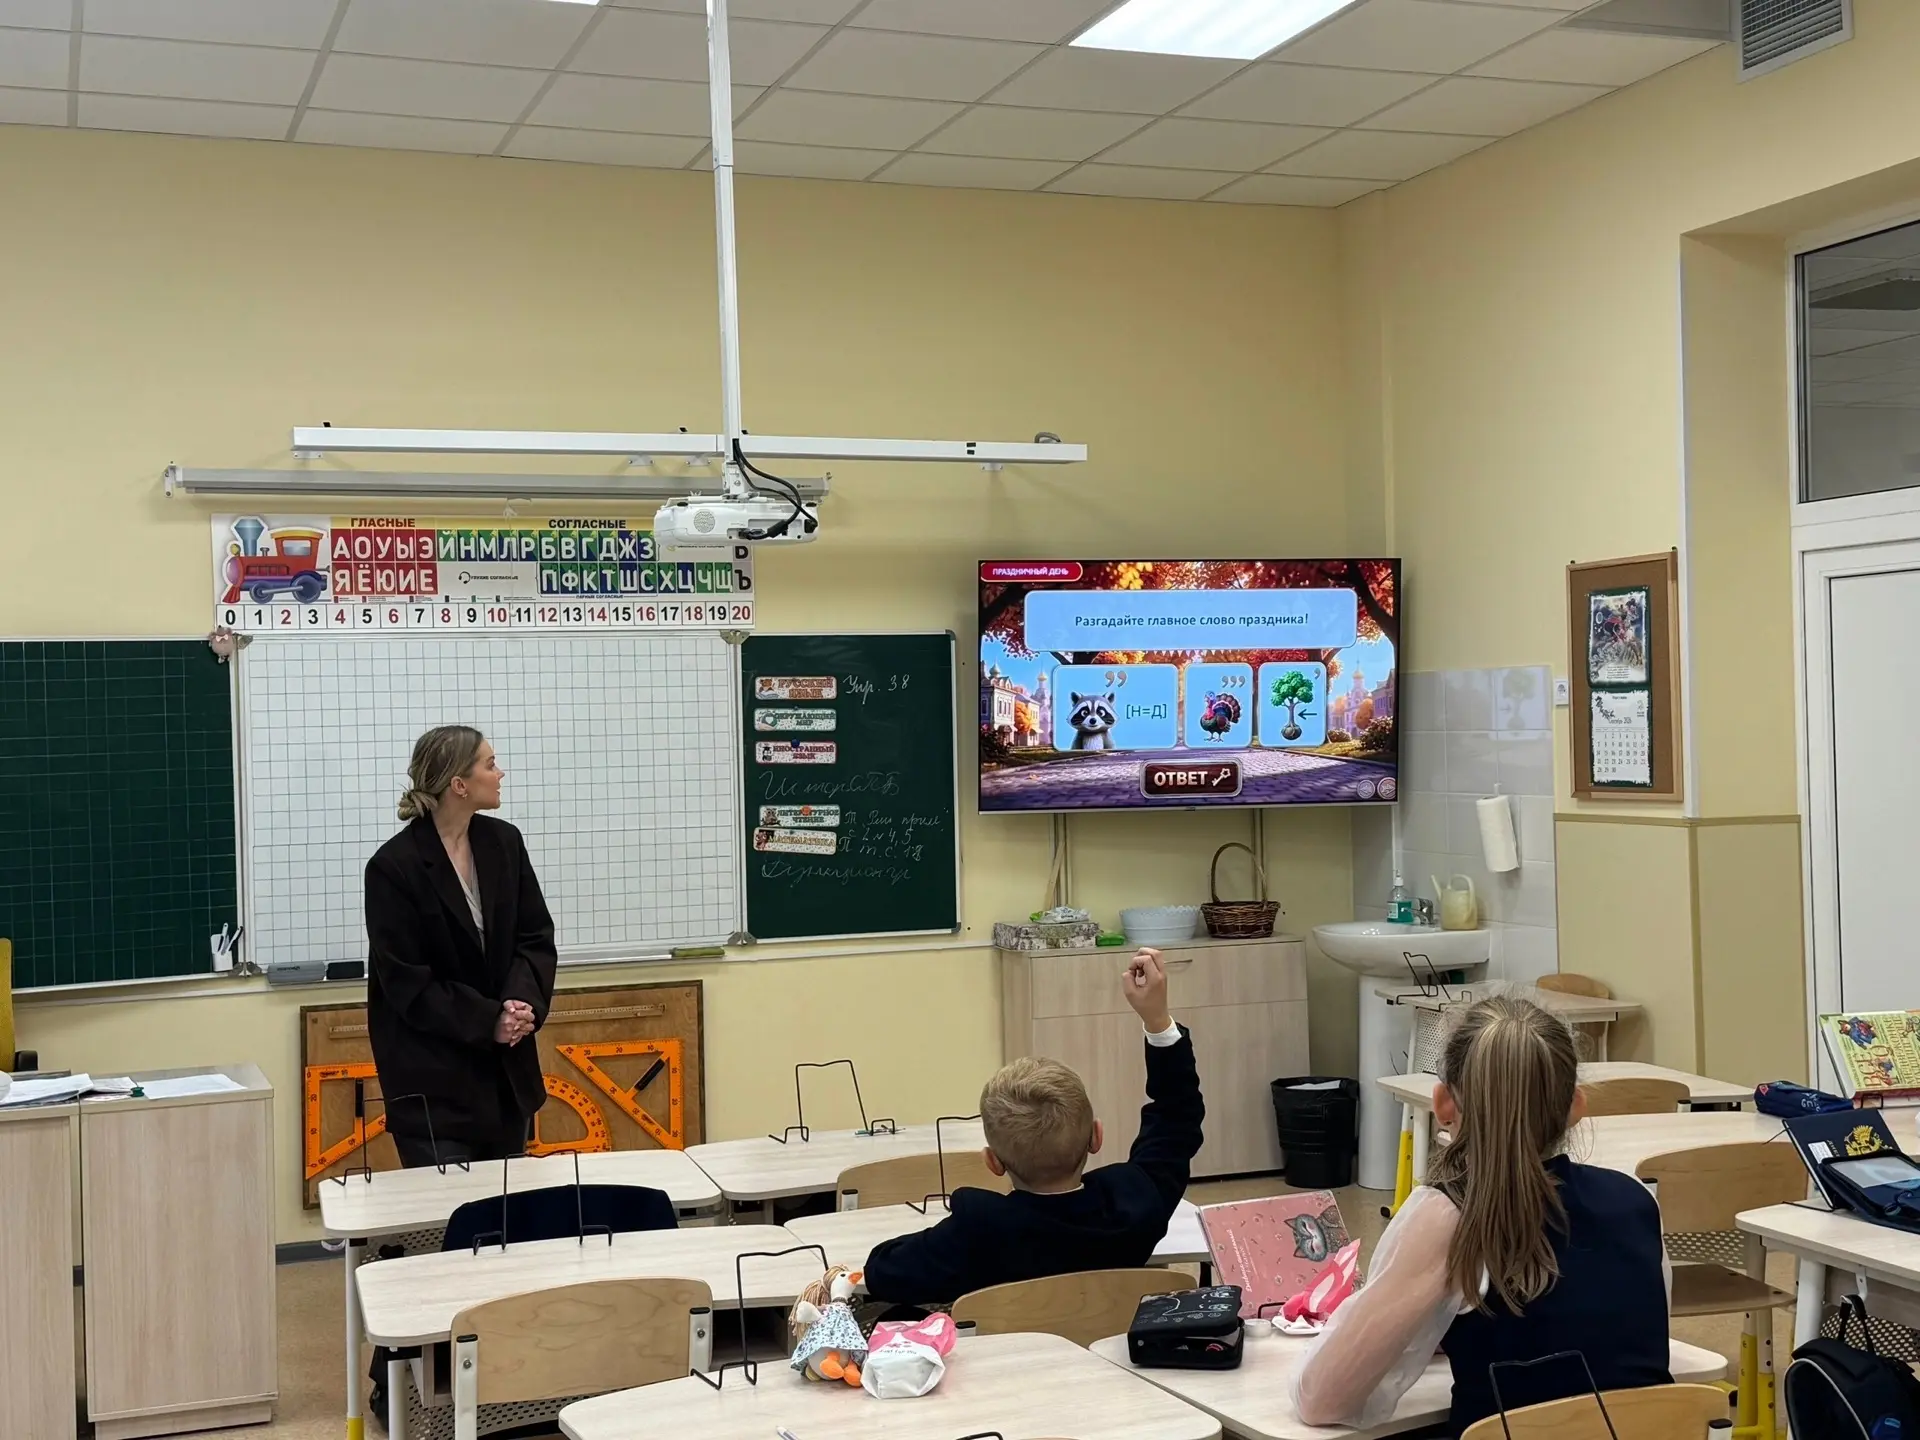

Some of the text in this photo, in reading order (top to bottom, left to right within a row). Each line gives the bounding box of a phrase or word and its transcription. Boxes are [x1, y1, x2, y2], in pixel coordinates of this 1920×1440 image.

[350, 518, 415, 528] ГЛАСНЫЕ
[548, 519, 626, 528] СОГЛАСНЫЕ
[992, 567, 1069, 576] ПРАЗДНИЧНЫЙ ДЕНЬ
[226, 605, 750, 625] 0 1 2 3 4 5 6 7 8 9 10 11 12 13 14 15 16 17 18 19 20
[1075, 613, 1308, 628] Разгадайте главное слово праздника!
[778, 677, 833, 688] РУССКИЙ
[888, 674, 910, 691] 38
[1126, 704, 1166, 719] [Н=Д]
[1154, 771, 1208, 786] ОТВЕТ
